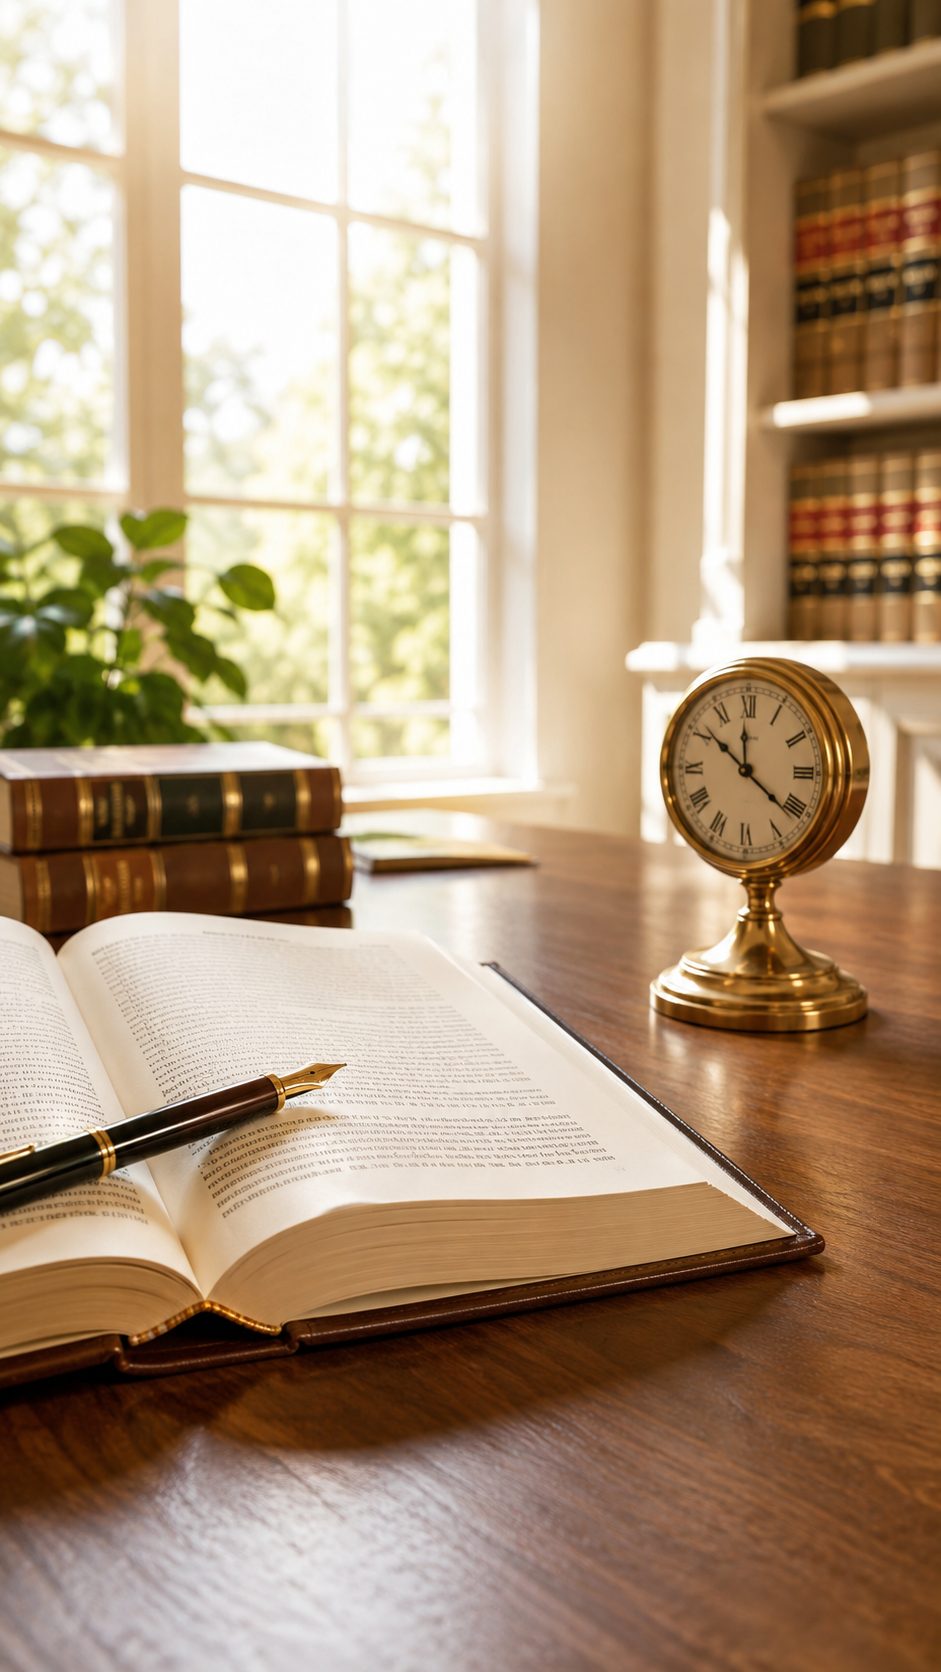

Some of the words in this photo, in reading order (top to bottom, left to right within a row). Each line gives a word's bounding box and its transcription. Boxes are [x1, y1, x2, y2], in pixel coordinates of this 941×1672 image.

[741, 695, 756, 718] XII
[770, 704, 783, 725] I
[785, 731, 806, 749] II
[793, 766, 814, 780] III
